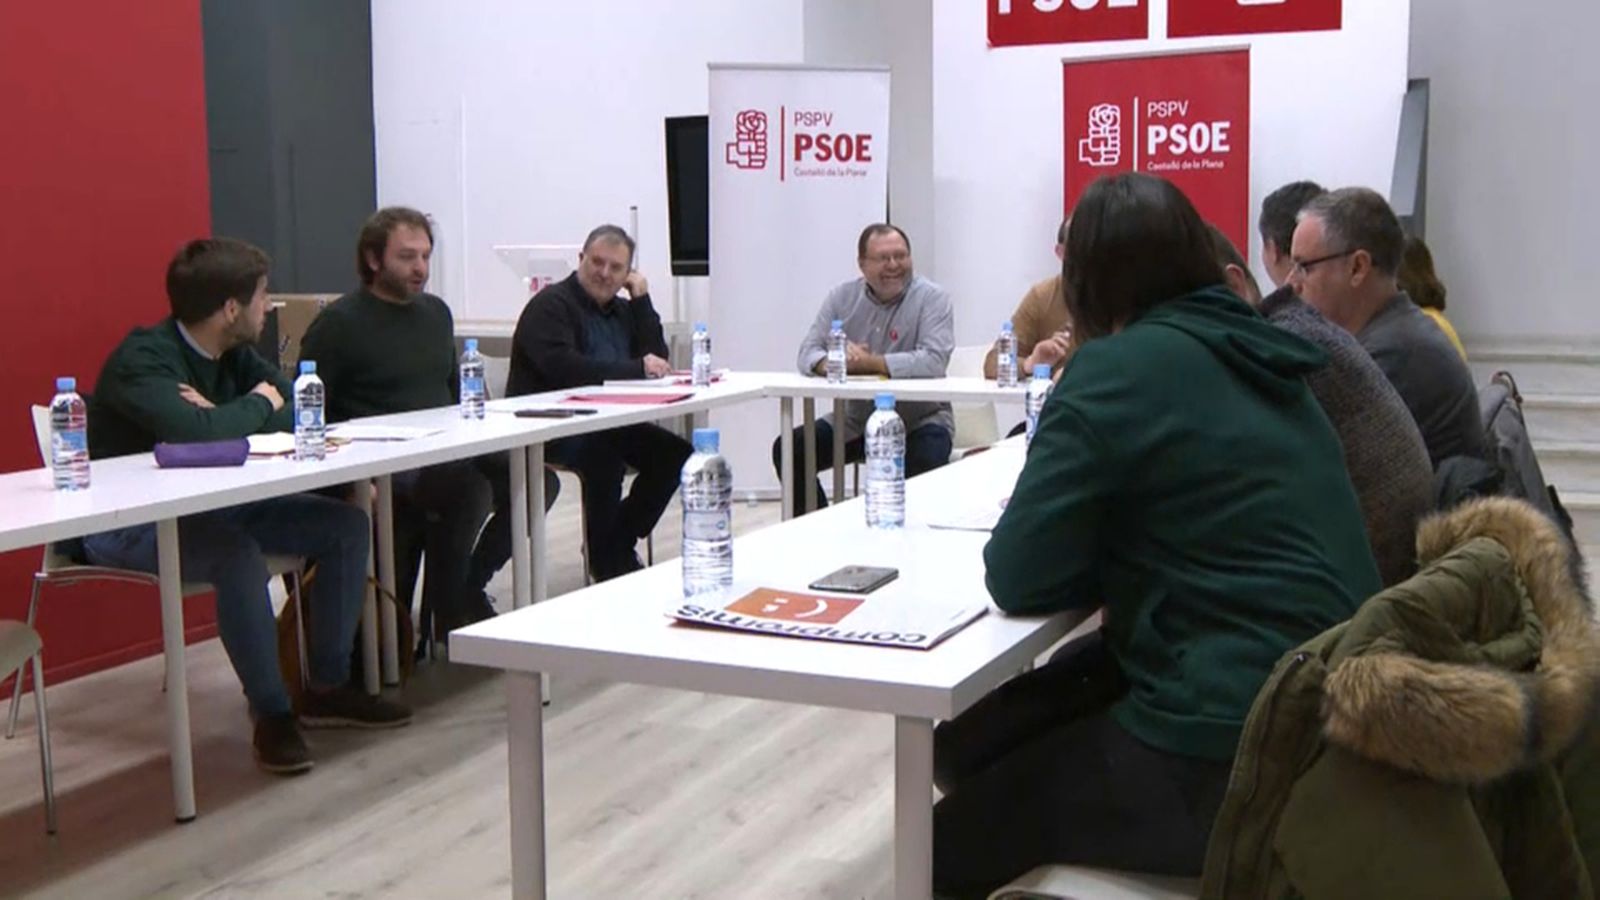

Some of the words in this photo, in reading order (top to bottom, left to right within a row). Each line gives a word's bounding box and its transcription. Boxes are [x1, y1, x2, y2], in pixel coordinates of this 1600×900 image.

[1147, 100, 1189, 118] PSPV
[794, 111, 833, 127] PSPV
[1147, 121, 1231, 155] PSOE
[794, 133, 872, 162] PSOE
[1181, 161, 1192, 170] de
